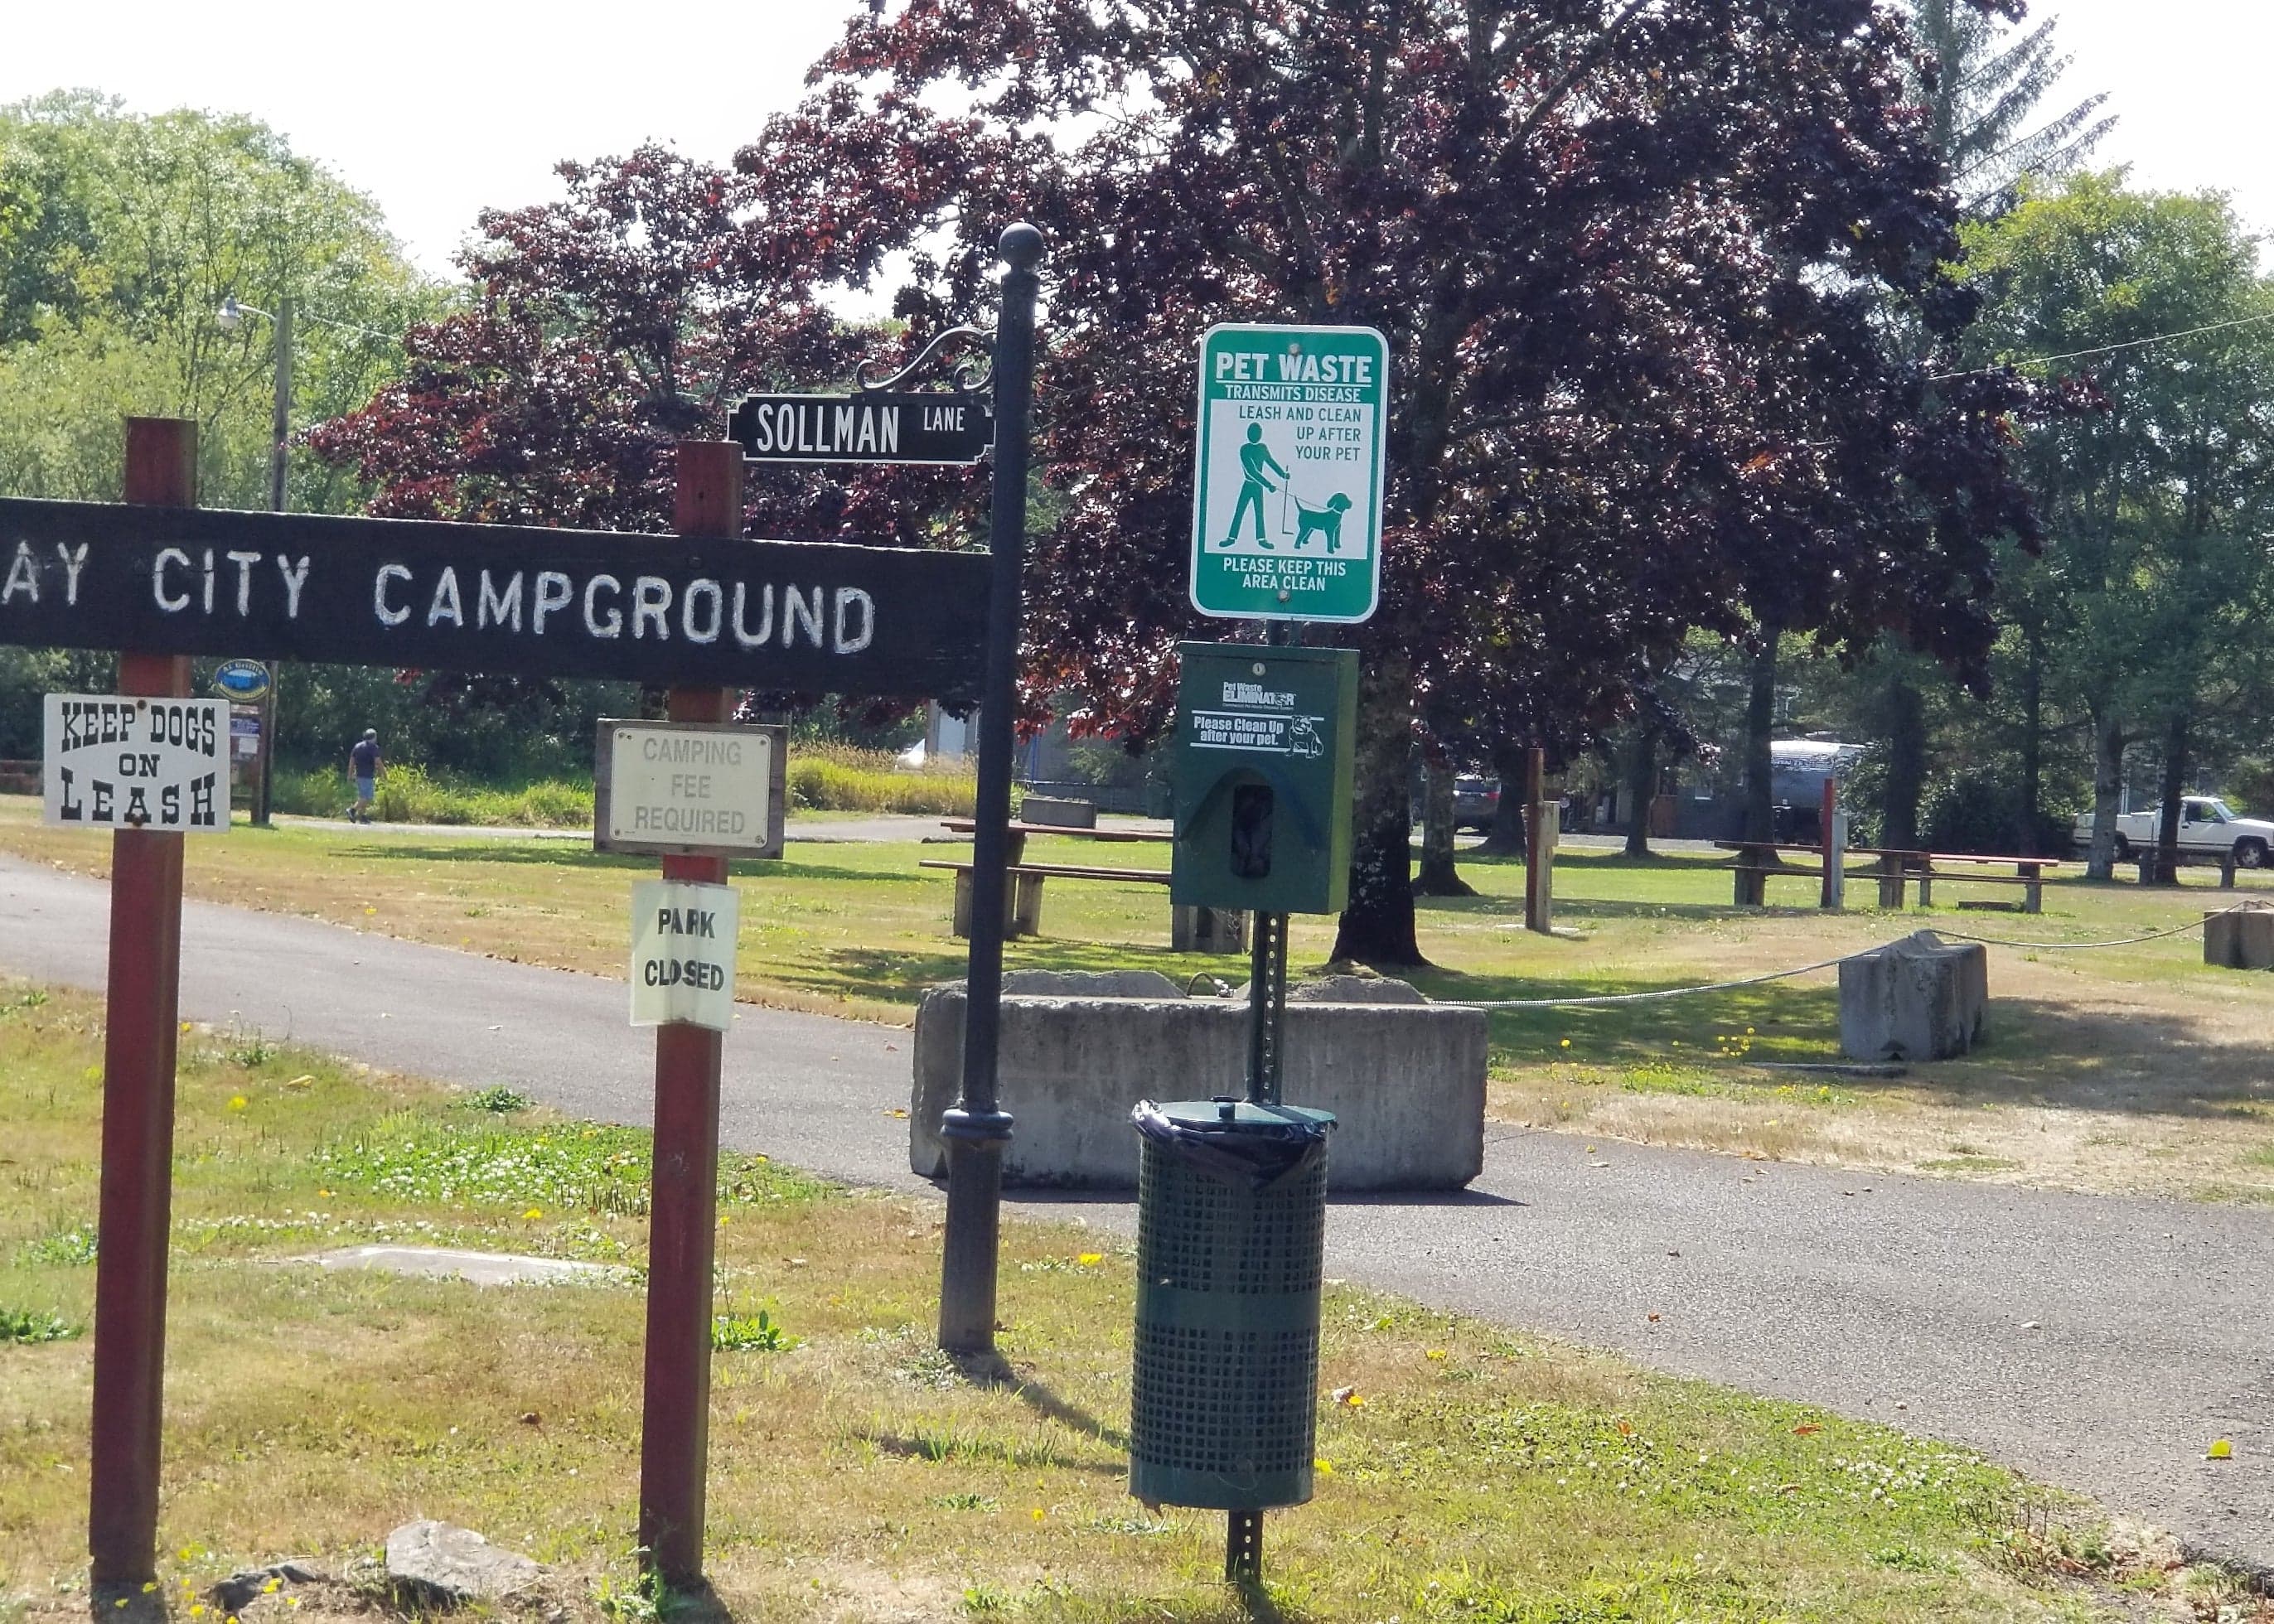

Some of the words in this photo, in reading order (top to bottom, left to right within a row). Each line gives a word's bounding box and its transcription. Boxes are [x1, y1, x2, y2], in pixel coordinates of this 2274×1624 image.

[1216, 351, 1269, 380] PET
[1279, 354, 1373, 384] WASTE
[1225, 384, 1301, 401] TRANSMITS
[1305, 387, 1361, 403] DISEASE
[1239, 405, 1281, 420] LEASH
[1286, 407, 1314, 421] AND
[1318, 408, 1362, 423] CLEAN
[757, 403, 899, 454] SOLLMAN
[923, 407, 965, 432] LANE
[1296, 427, 1314, 441] UP
[1318, 427, 1362, 442] AFTER
[1295, 445, 1331, 461] YOUR
[1336, 447, 1360, 462] PET
[1223, 557, 1274, 573] PLEASE
[1278, 559, 1313, 575] KEEP
[1316, 561, 1346, 576] THIS
[1242, 573, 1278, 589] AREA
[1283, 575, 1326, 592] CLEAN
[152, 547, 311, 619] CITY
[375, 563, 875, 654] CAMPGROUND
[1223, 682, 1236, 691] Pet
[61, 702, 136, 753] KEEP
[151, 704, 215, 757] DOGS
[1193, 716, 1232, 731] Please
[1234, 718, 1267, 732] Clean
[1269, 720, 1285, 734] Up
[1200, 728, 1228, 742] after
[1229, 731, 1256, 744] your
[1256, 733, 1279, 746] pet.
[642, 737, 743, 766] CAMPING
[119, 752, 160, 777] ON
[60, 766, 215, 826] LEASH
[671, 773, 711, 799] FEE
[635, 805, 745, 835] REQUIRED
[657, 907, 715, 939] PARK
[644, 958, 725, 992] CLOSED
